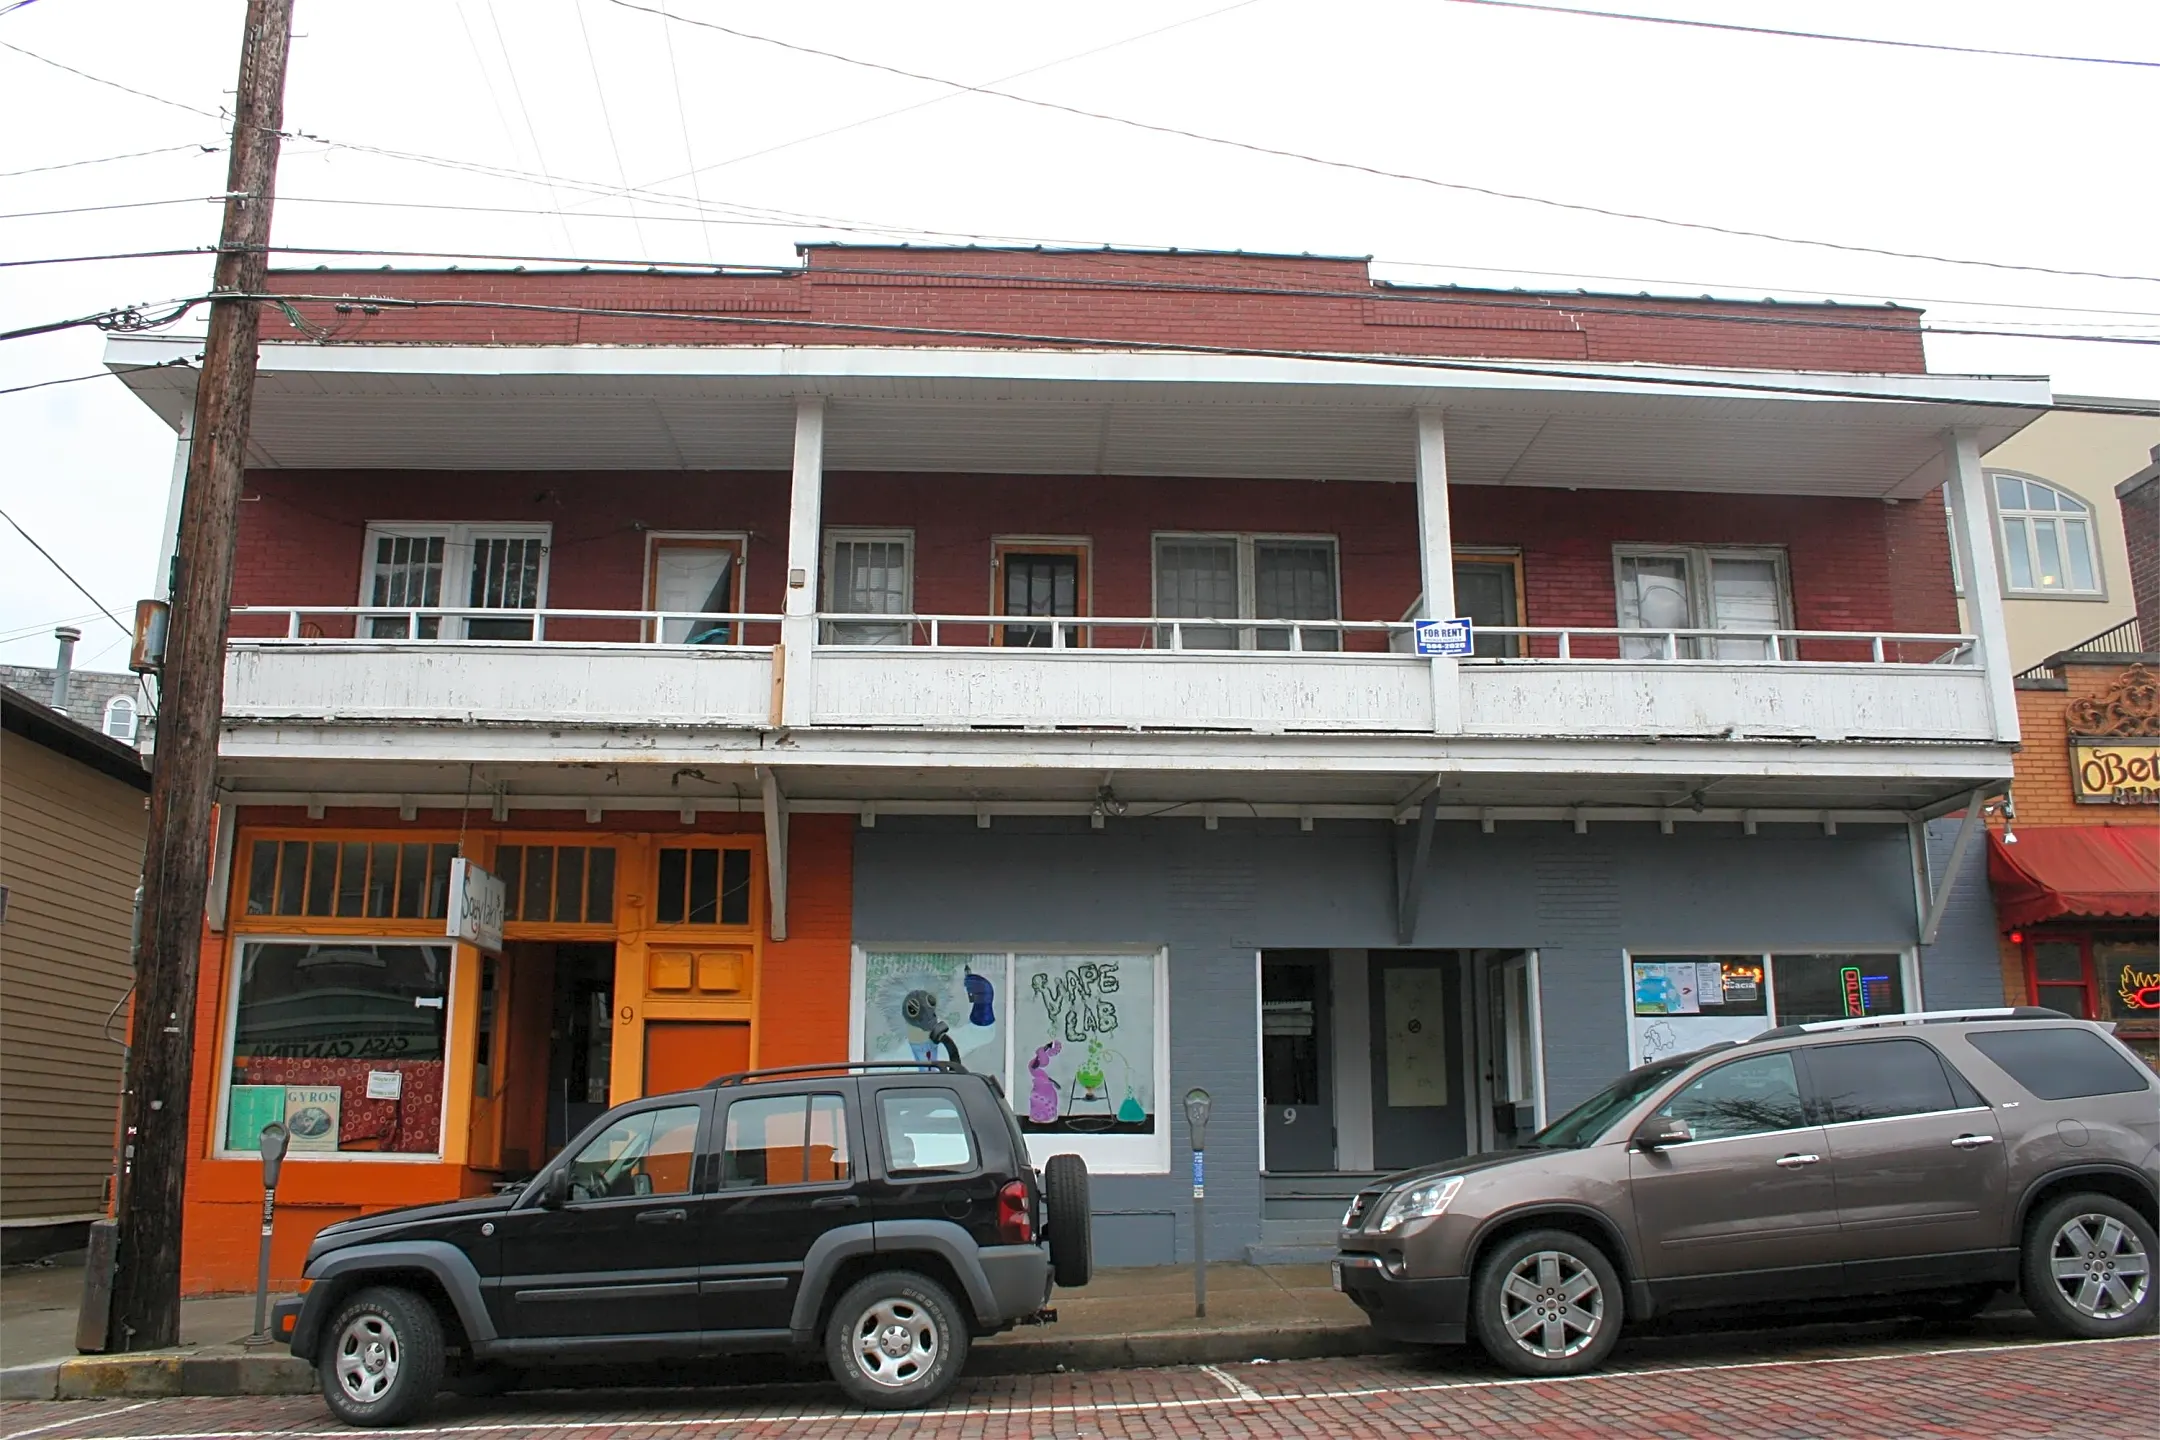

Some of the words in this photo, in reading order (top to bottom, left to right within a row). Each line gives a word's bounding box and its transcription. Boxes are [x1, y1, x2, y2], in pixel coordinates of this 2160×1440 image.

[1424, 628, 1440, 638] FOR
[1442, 628, 1463, 637] RENT
[1031, 961, 1120, 1022] VAPE
[1845, 971, 1862, 1016] OPEN
[620, 1005, 634, 1026] 9
[1065, 999, 1119, 1042] LAB
[287, 1091, 338, 1104] GYROS
[1283, 1107, 1297, 1125] 9
